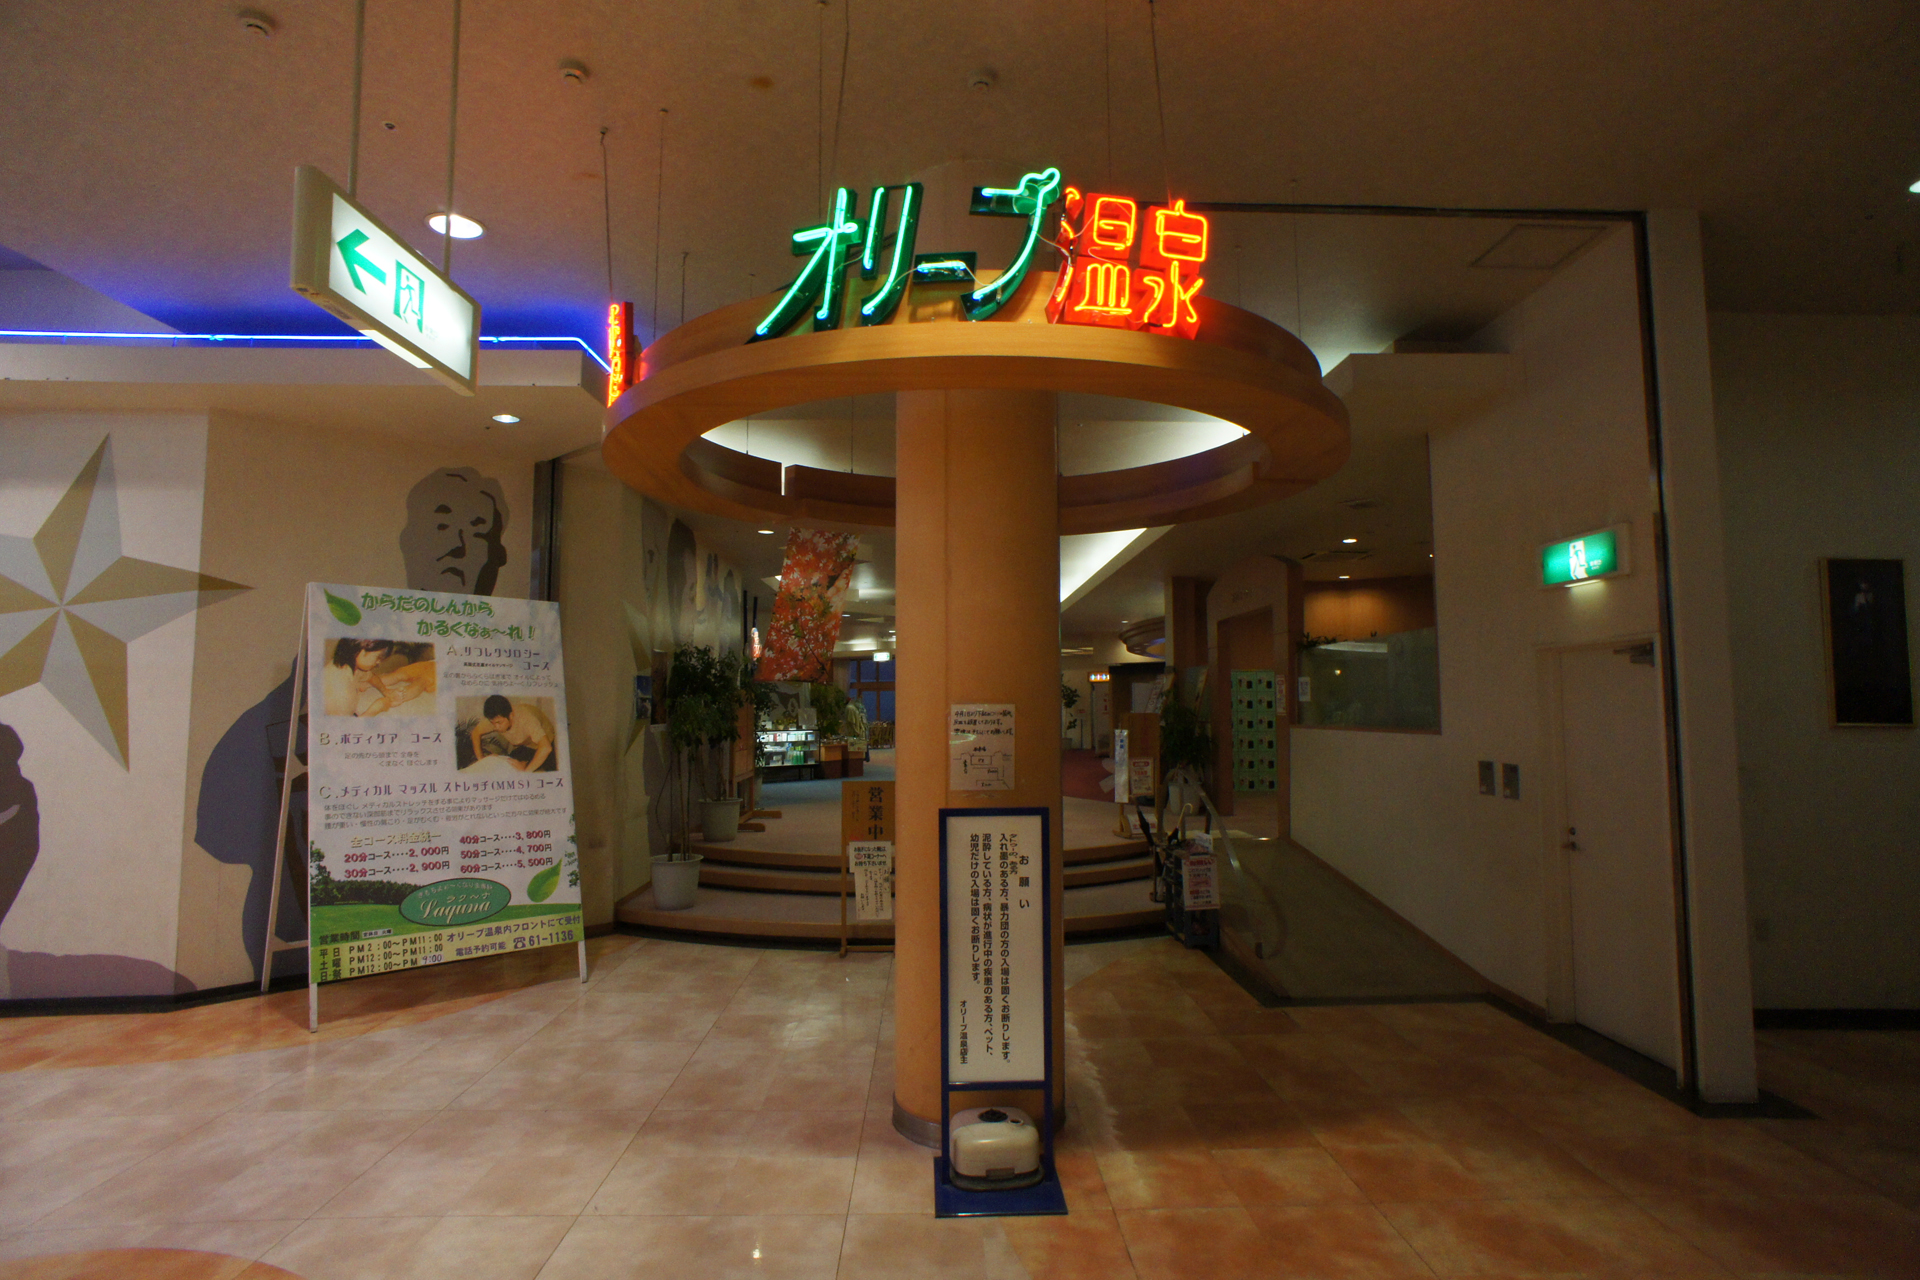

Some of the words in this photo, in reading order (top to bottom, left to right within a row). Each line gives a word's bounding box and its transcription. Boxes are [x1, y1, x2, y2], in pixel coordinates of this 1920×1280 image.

[361, 592, 495, 618] からだのしんから
[522, 661, 551, 671] コース
[411, 732, 442, 743] コース
[400, 781, 437, 794] マッスル
[537, 776, 564, 789] コース
[868, 786, 885, 840] 営業中
[1018, 854, 1031, 910] お願い
[420, 898, 492, 924] Laguna
[970, 833, 981, 985] 幼児だけの入場は固くお断りします。
[319, 931, 360, 946] 営業時間
[446, 914, 581, 942] オリーブ温泉内フロントにて受付
[456, 941, 506, 957] 電話予約可能
[999, 833, 1011, 1064] 入れ墨のある方、暴力団の方の入場は固くお断りします。
